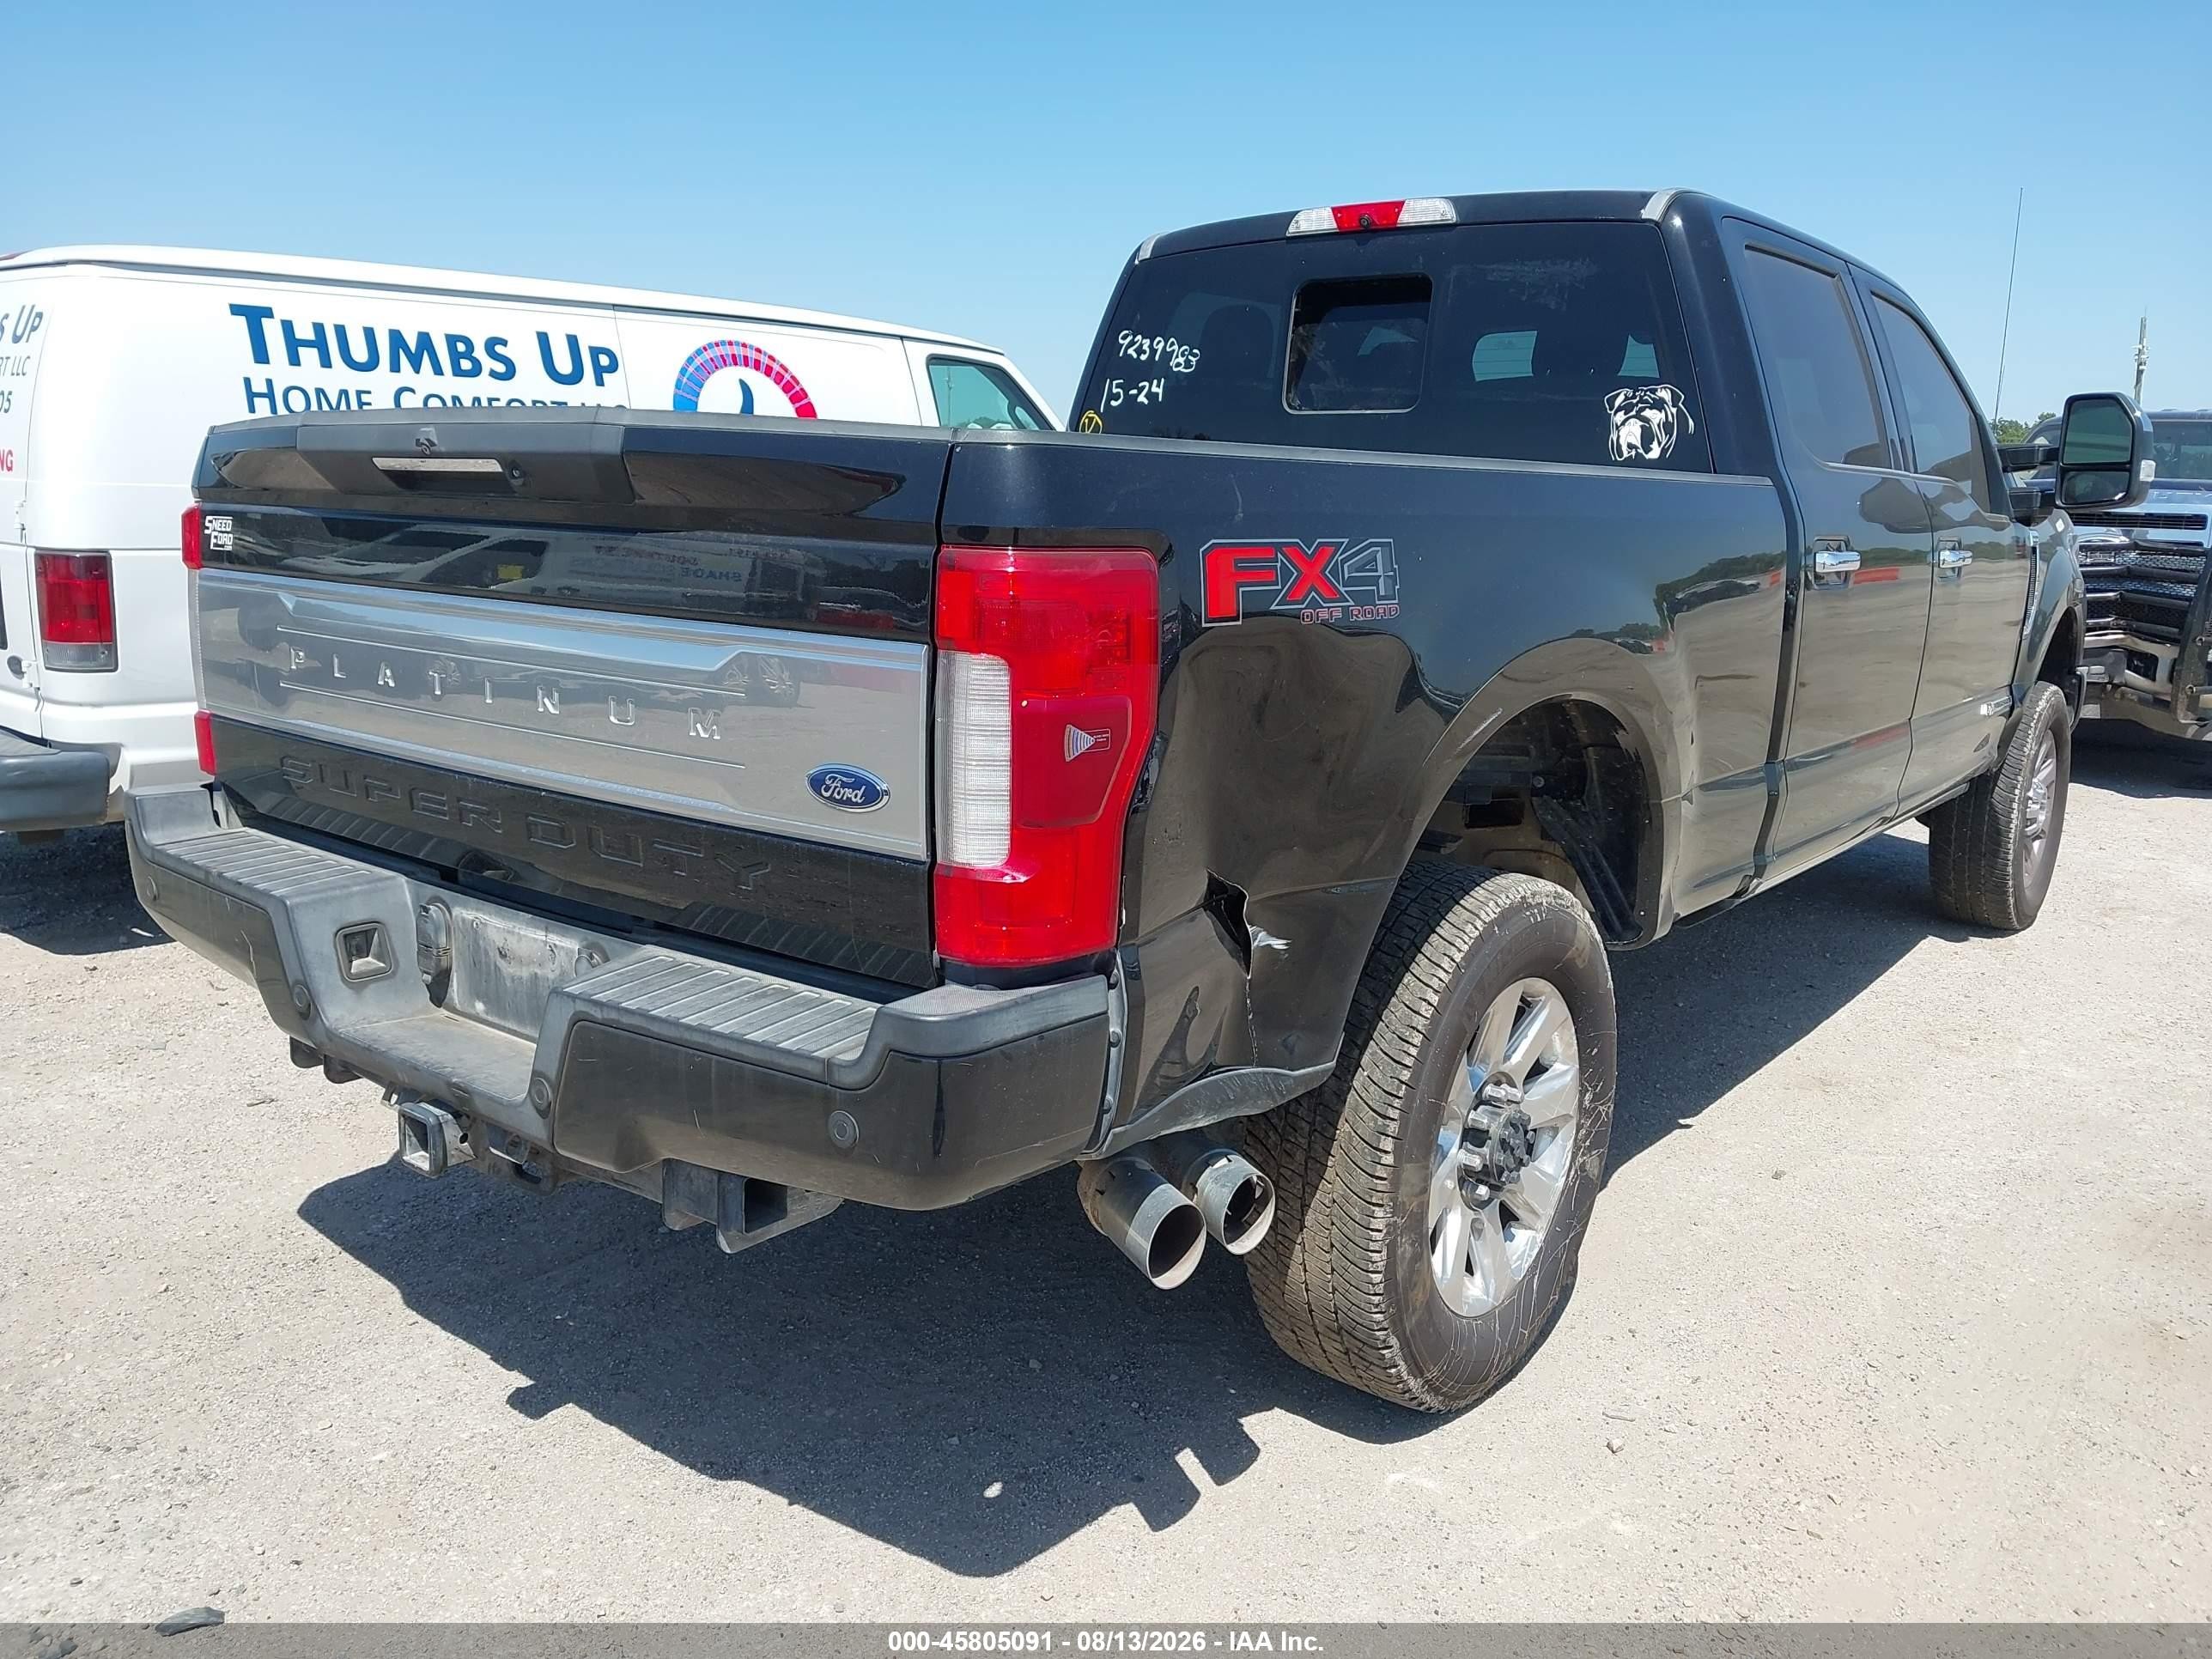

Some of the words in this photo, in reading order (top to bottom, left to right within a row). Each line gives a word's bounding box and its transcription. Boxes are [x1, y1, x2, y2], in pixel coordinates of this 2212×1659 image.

[12, 304, 44, 343] UP
[228, 303, 516, 380] THUMBS
[536, 331, 619, 386] UP
[11, 355, 31, 377] LLC
[243, 377, 373, 415] HOME
[1101, 377, 1165, 412] 15-24
[204, 516, 233, 534] SNEED
[1200, 538, 1400, 627] FX4
[1300, 608, 1342, 624] OFF
[1349, 605, 1401, 622] ROAD
[289, 646, 721, 740] PLATINUM
[821, 774, 866, 803] Ford
[280, 755, 504, 834] SUPER
[526, 812, 771, 890] DUTY
